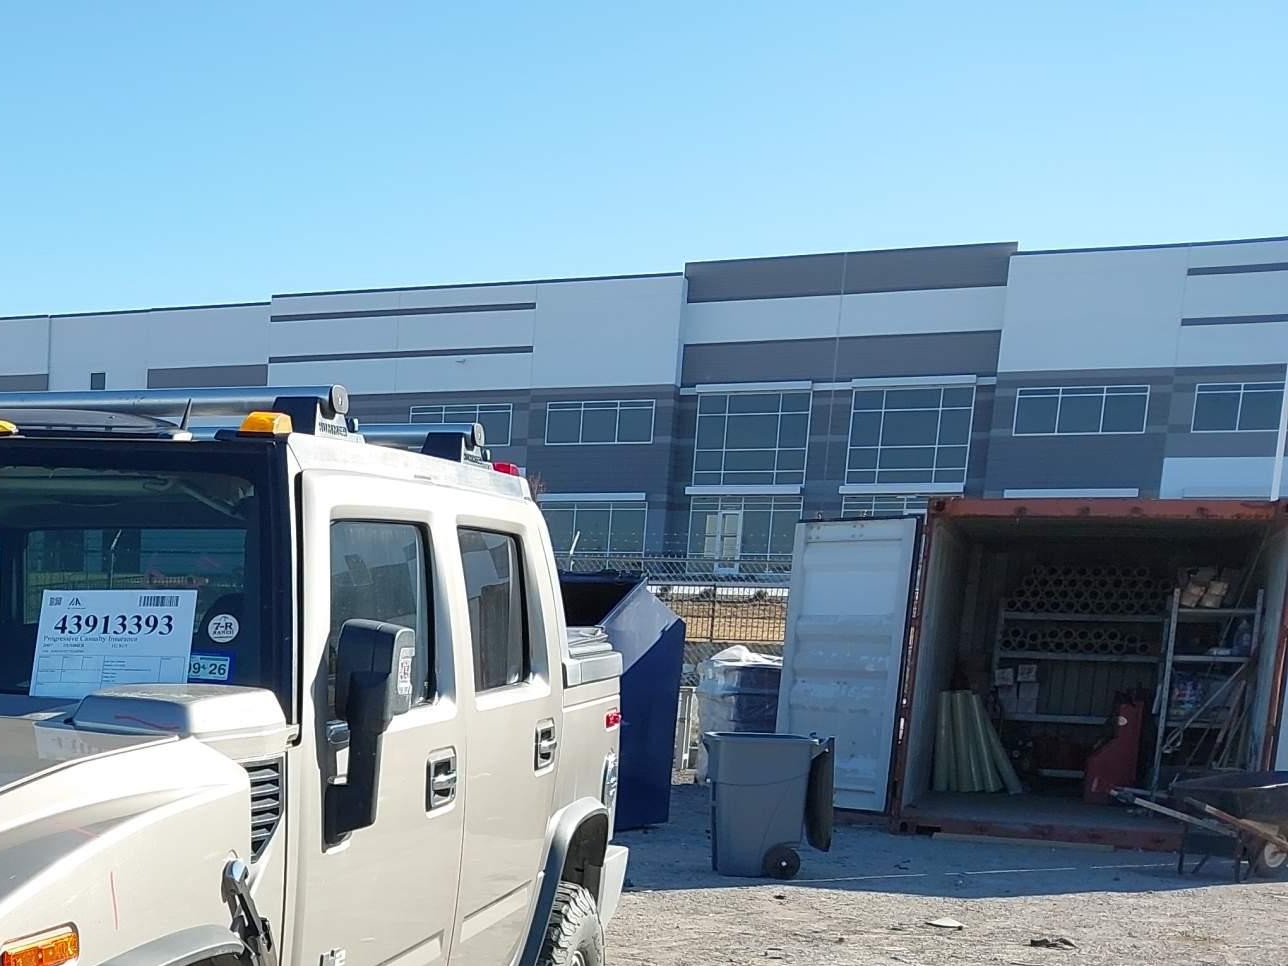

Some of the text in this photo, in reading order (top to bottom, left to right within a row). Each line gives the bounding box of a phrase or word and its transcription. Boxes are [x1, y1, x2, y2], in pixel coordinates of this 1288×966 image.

[54, 613, 174, 635] 43913393
[80, 635, 107, 643] Casualty
[108, 635, 138, 643] Insurance
[208, 663, 226, 675] 26
